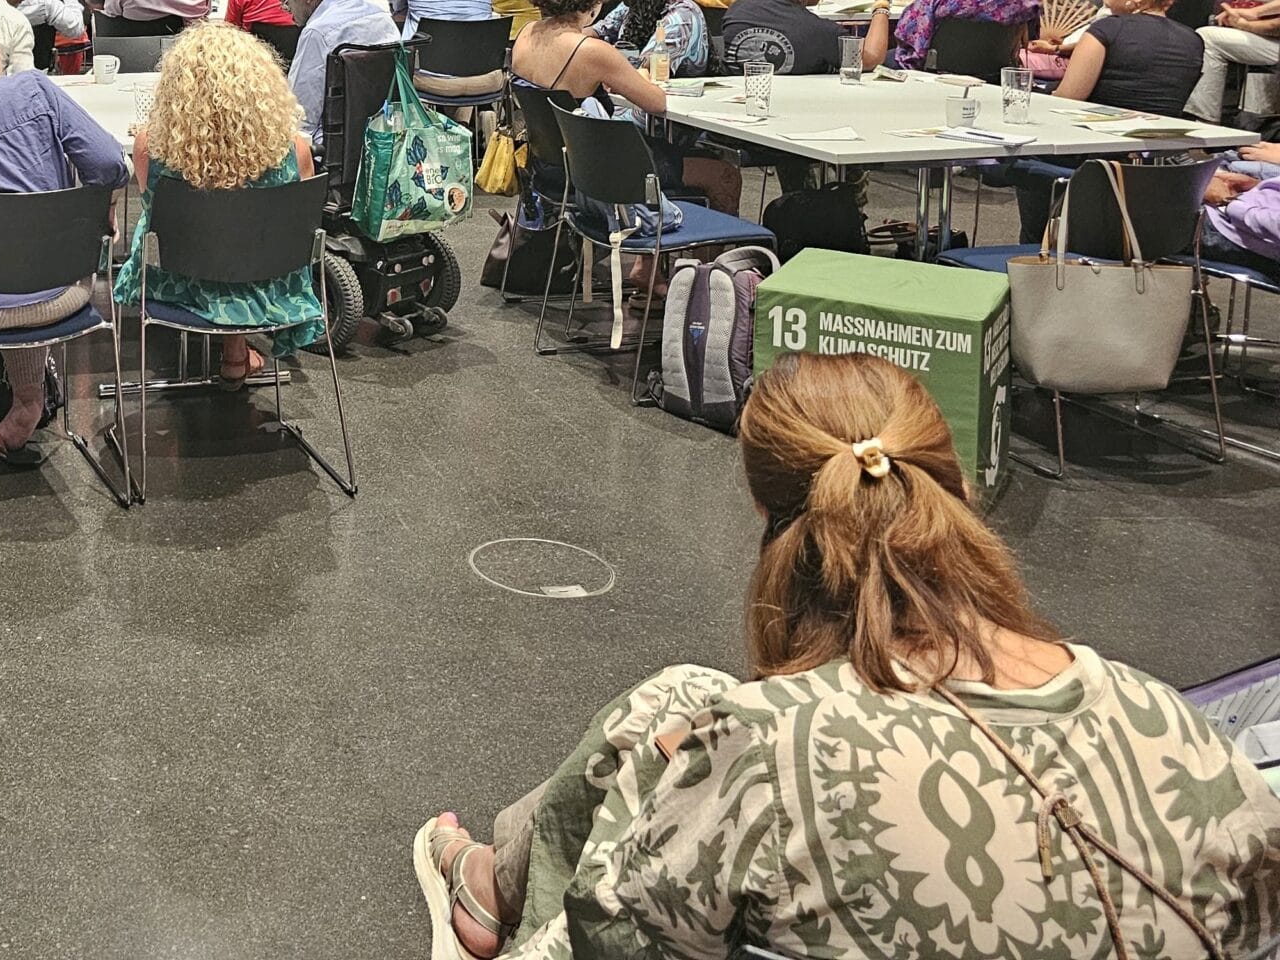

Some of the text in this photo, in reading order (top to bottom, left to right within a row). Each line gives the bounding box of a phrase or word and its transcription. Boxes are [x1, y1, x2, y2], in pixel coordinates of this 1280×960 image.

[768, 305, 807, 351] 13
[819, 311, 933, 348] MASSNAHMEN
[935, 329, 973, 354] ZUM
